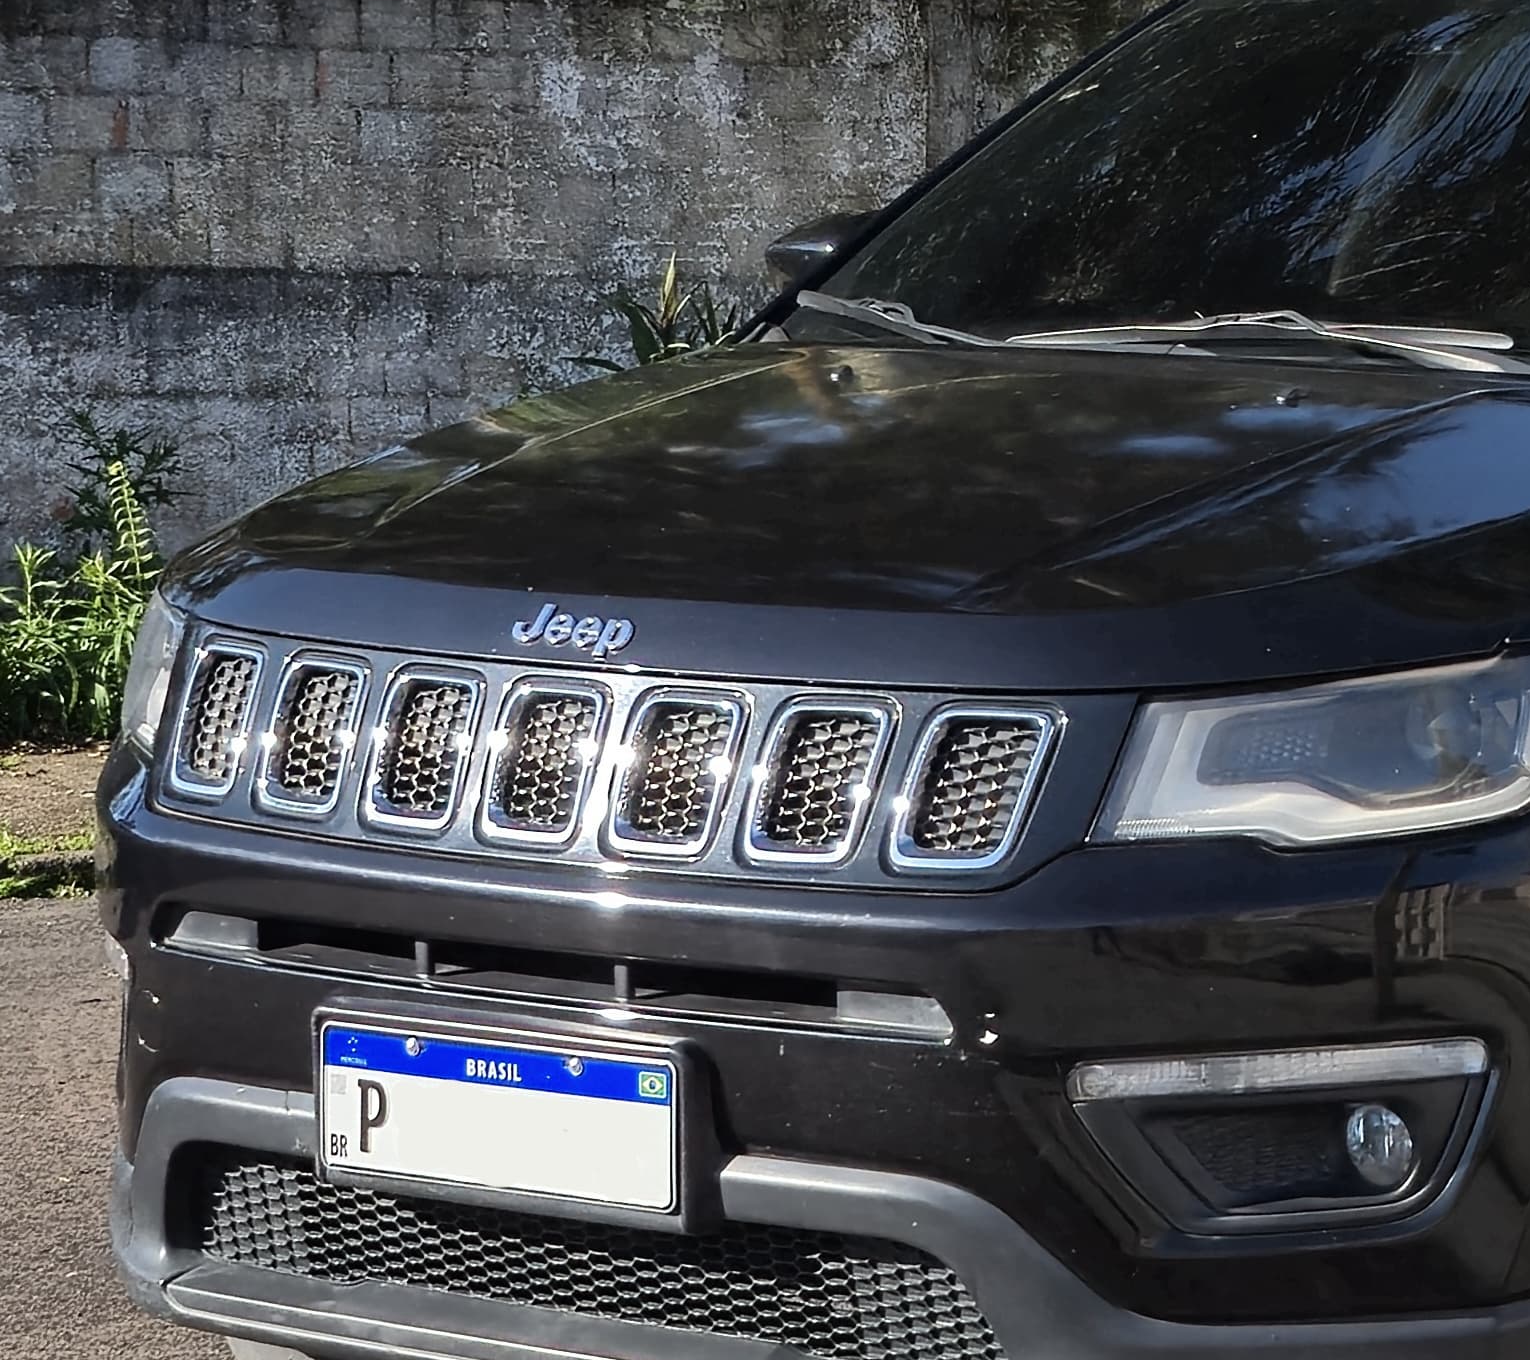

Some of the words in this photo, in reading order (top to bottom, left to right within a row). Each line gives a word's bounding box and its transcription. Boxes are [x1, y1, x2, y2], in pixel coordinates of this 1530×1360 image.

[512, 602, 635, 657] Jeep
[466, 1057, 522, 1082] BRASIL
[330, 1133, 348, 1157] BR
